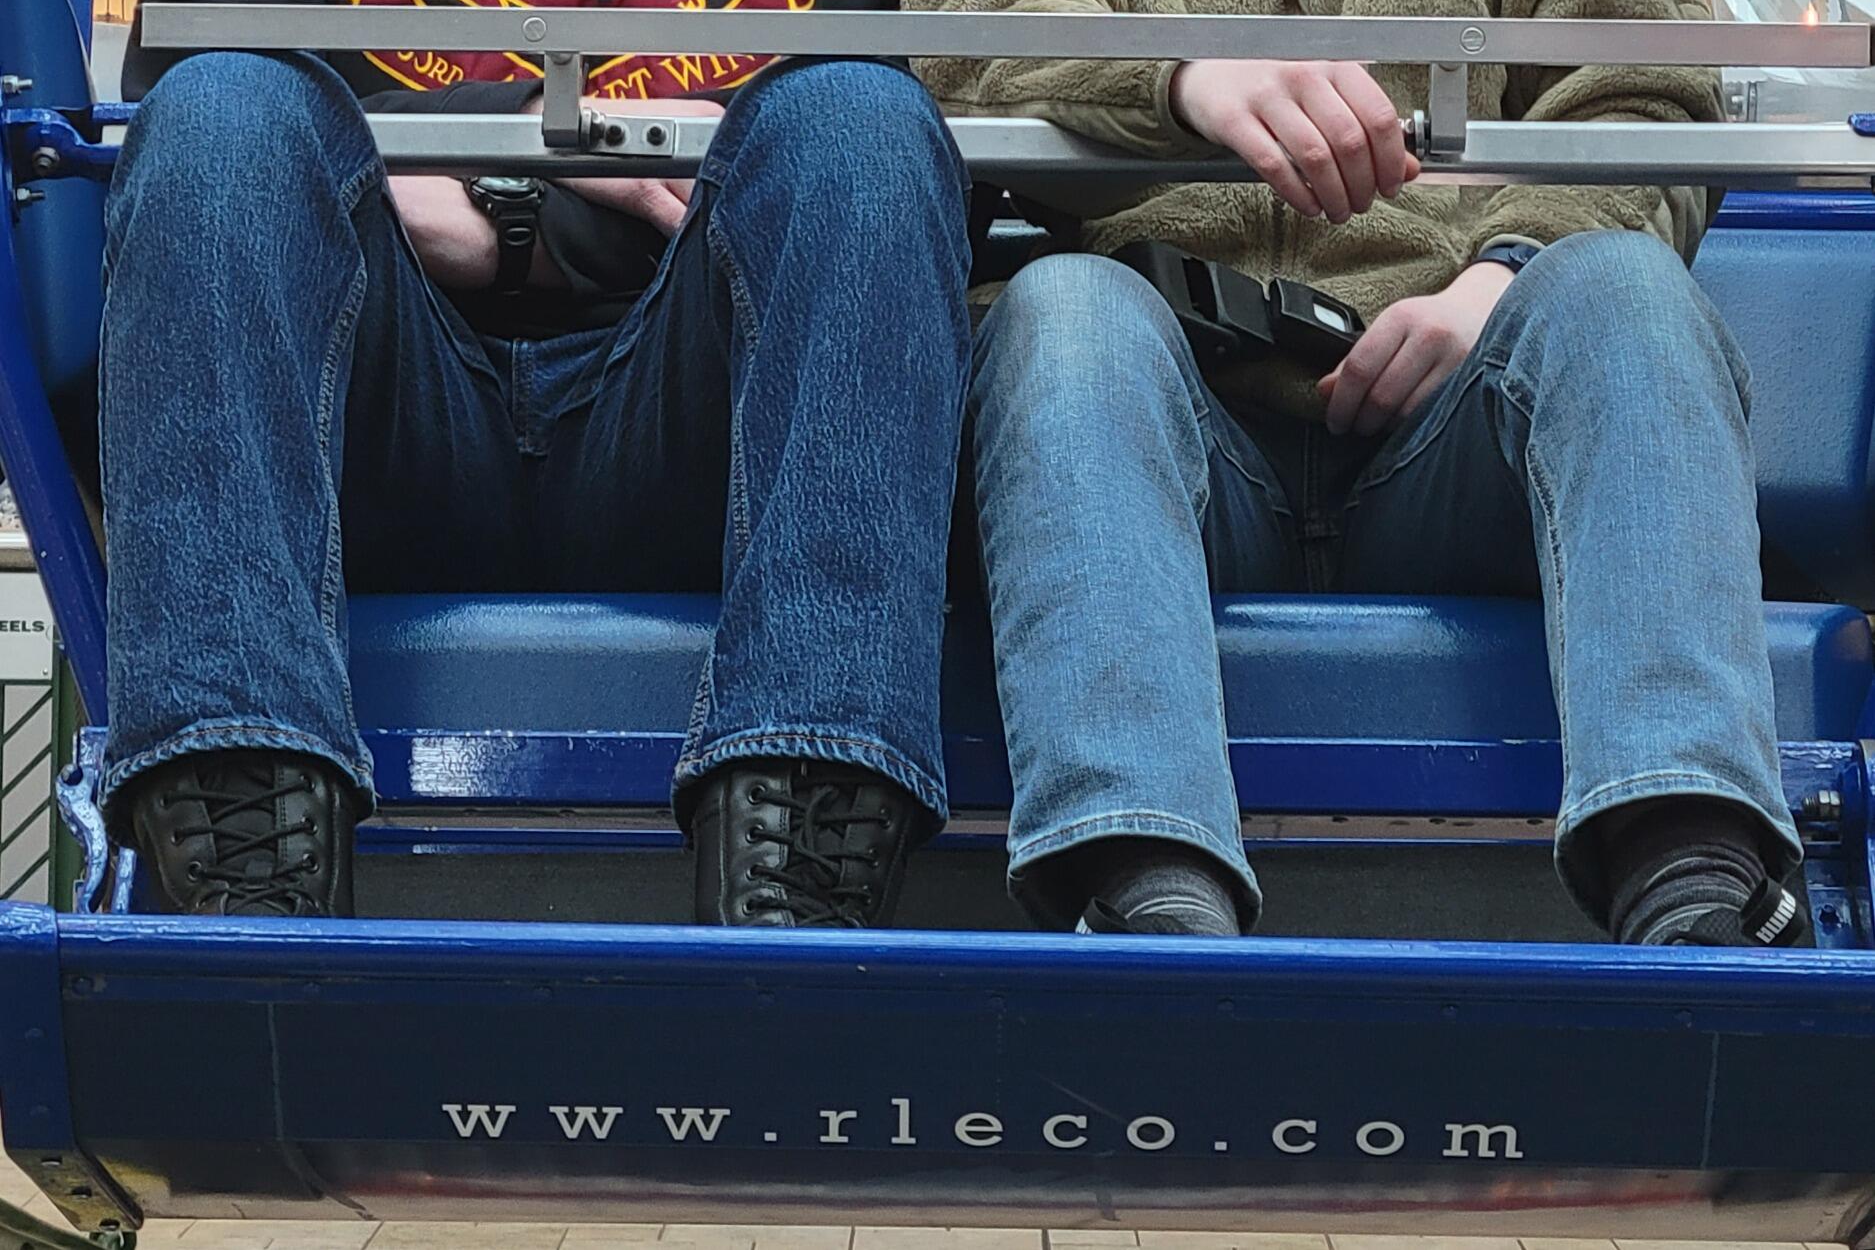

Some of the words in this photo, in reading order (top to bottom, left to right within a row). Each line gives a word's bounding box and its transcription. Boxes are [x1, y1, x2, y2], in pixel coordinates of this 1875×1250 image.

[0, 620, 45, 632] EELS
[1755, 887, 1796, 944] PUMA
[442, 1098, 1523, 1158] www.rleco.com
